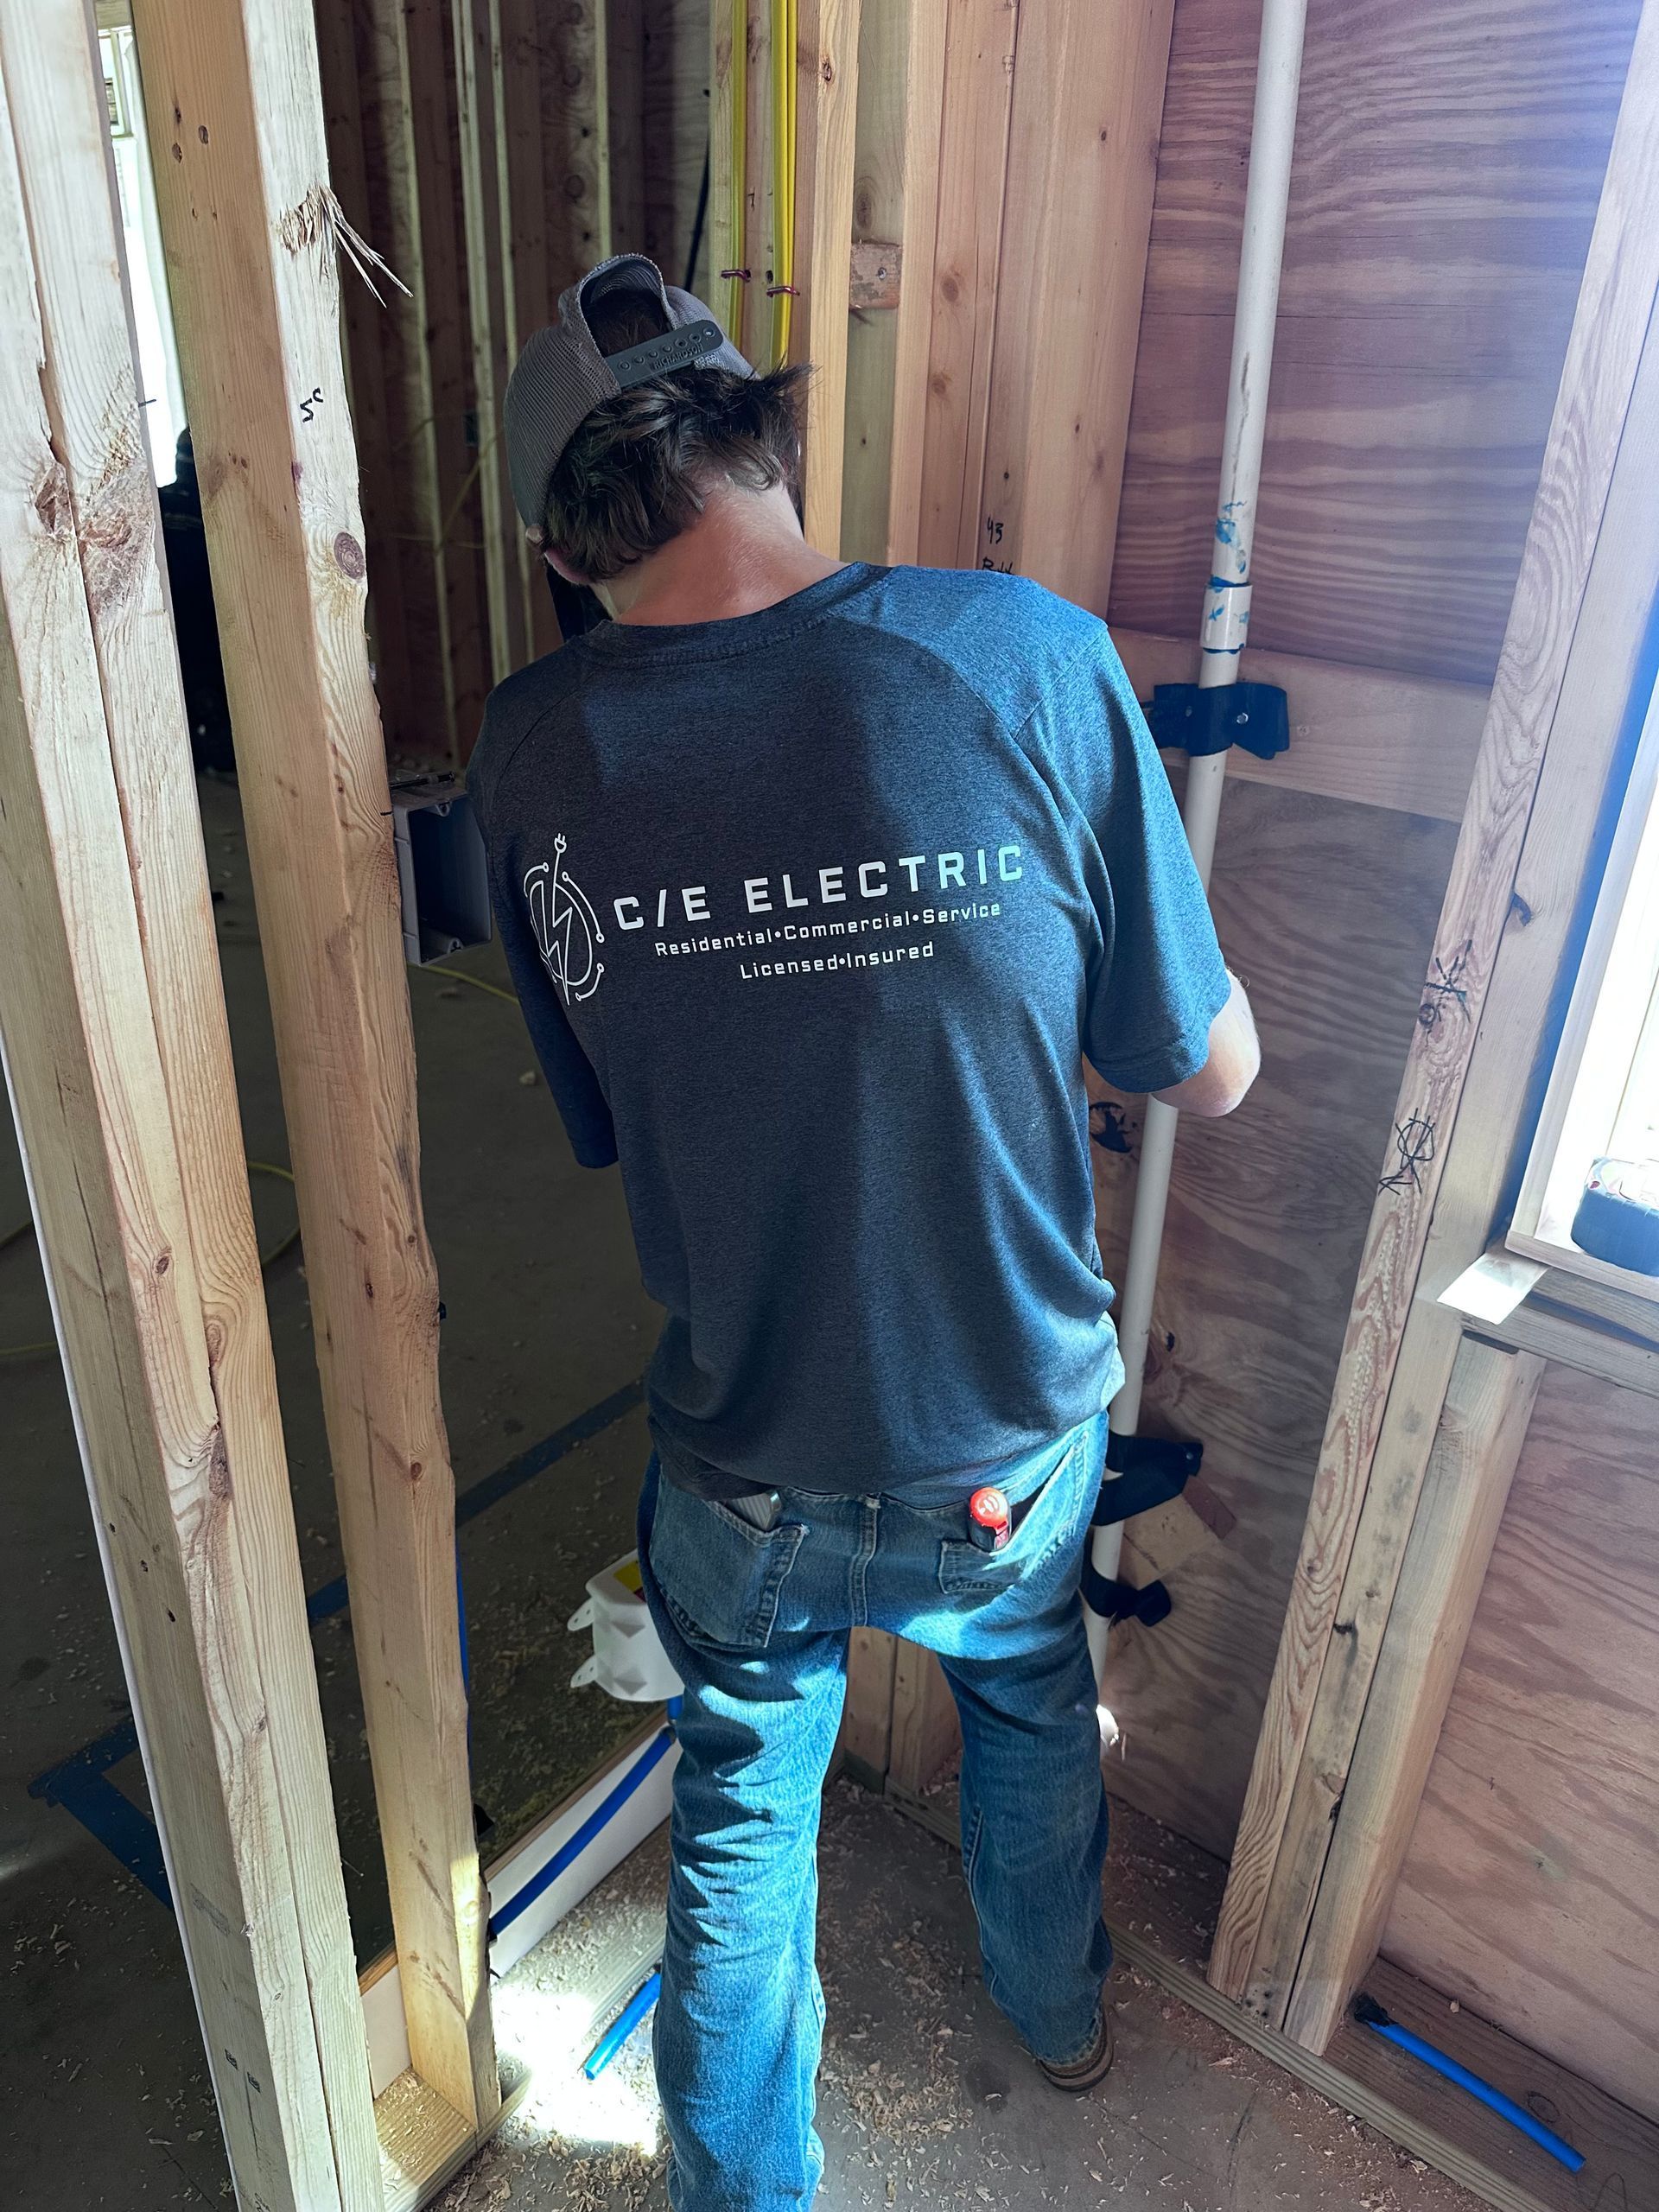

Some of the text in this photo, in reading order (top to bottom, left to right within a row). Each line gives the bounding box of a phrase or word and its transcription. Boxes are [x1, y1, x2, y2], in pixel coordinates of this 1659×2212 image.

[653, 341, 704, 370] RICHARDSON
[613, 845, 1023, 931] C/E ELECTRIC
